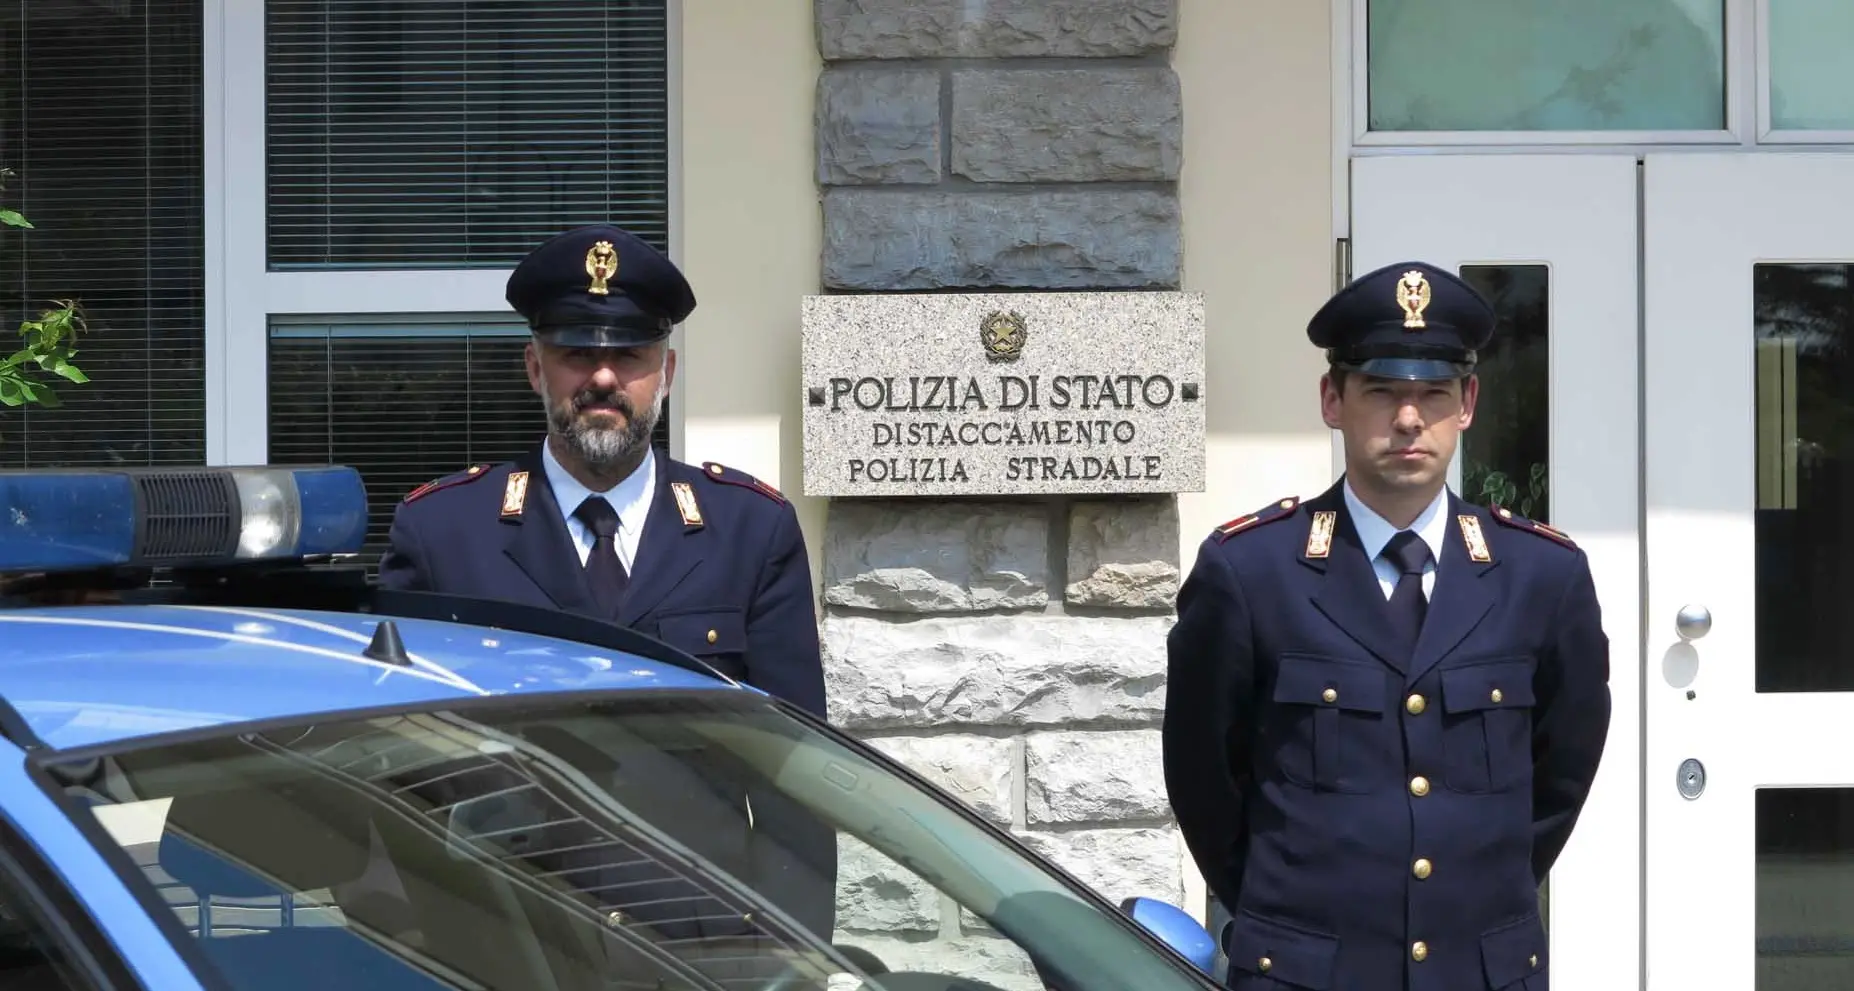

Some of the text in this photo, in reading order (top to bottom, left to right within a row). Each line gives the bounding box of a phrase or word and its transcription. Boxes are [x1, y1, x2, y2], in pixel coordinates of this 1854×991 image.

[830, 374, 1175, 412] POLIZIA DI STATO
[873, 420, 1136, 447] DISTACCAMENTO
[849, 456, 1162, 483] POLIZIA STRADALE
